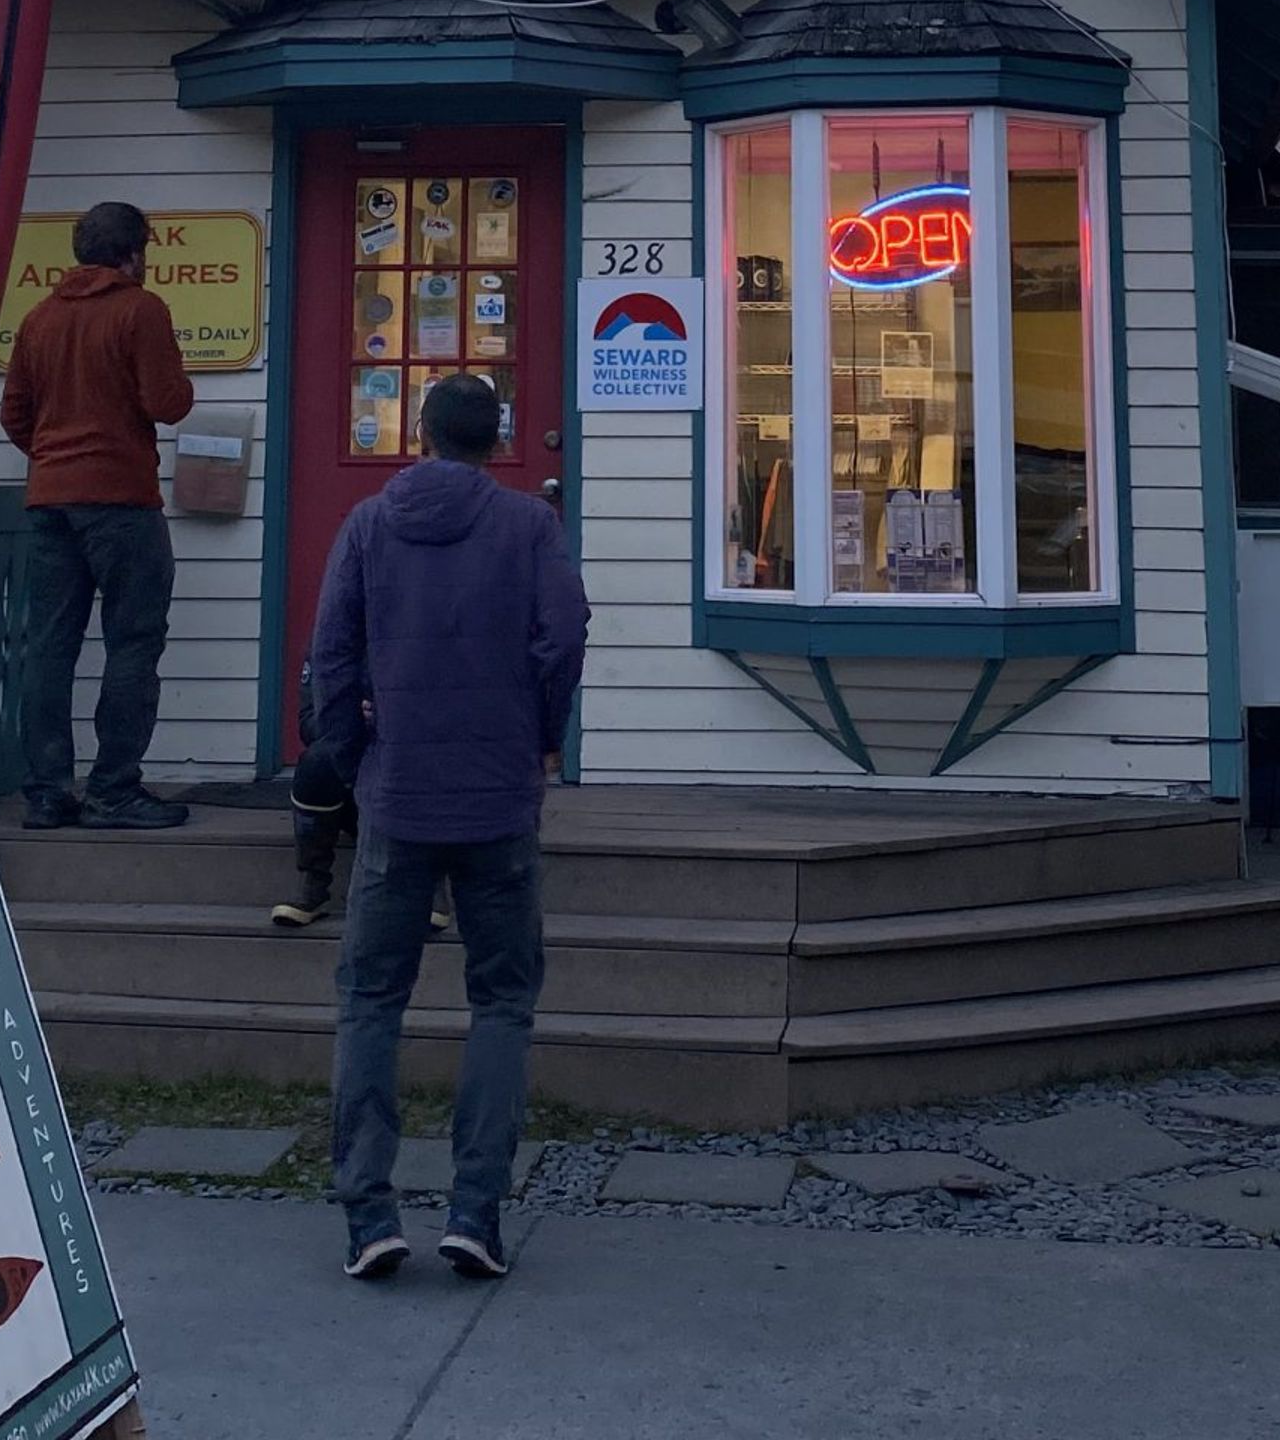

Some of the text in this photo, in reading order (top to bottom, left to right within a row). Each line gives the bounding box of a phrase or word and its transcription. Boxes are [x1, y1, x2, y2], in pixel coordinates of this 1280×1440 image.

[597, 243, 666, 276] 328
[593, 348, 687, 366] SEWARD
[593, 368, 687, 381] WILDERNESS
[593, 383, 687, 396] COLLECTIVE
[2, 1007, 90, 1296] ADVENTURES
